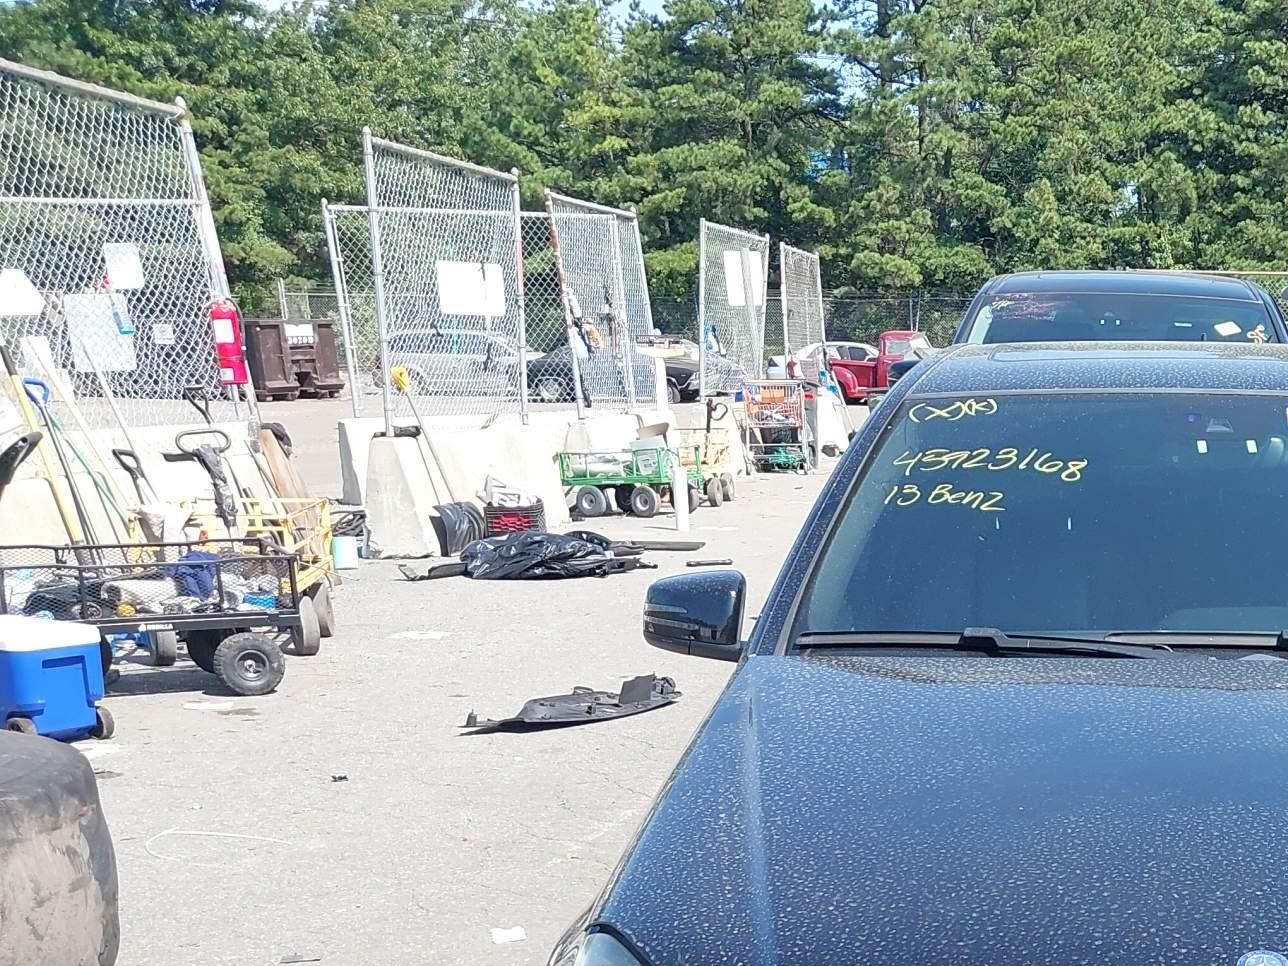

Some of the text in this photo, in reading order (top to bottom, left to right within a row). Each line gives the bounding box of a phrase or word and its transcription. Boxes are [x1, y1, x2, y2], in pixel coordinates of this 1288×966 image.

[892, 448, 1088, 481] 45923168
[884, 484, 1006, 511] 13 Benz
